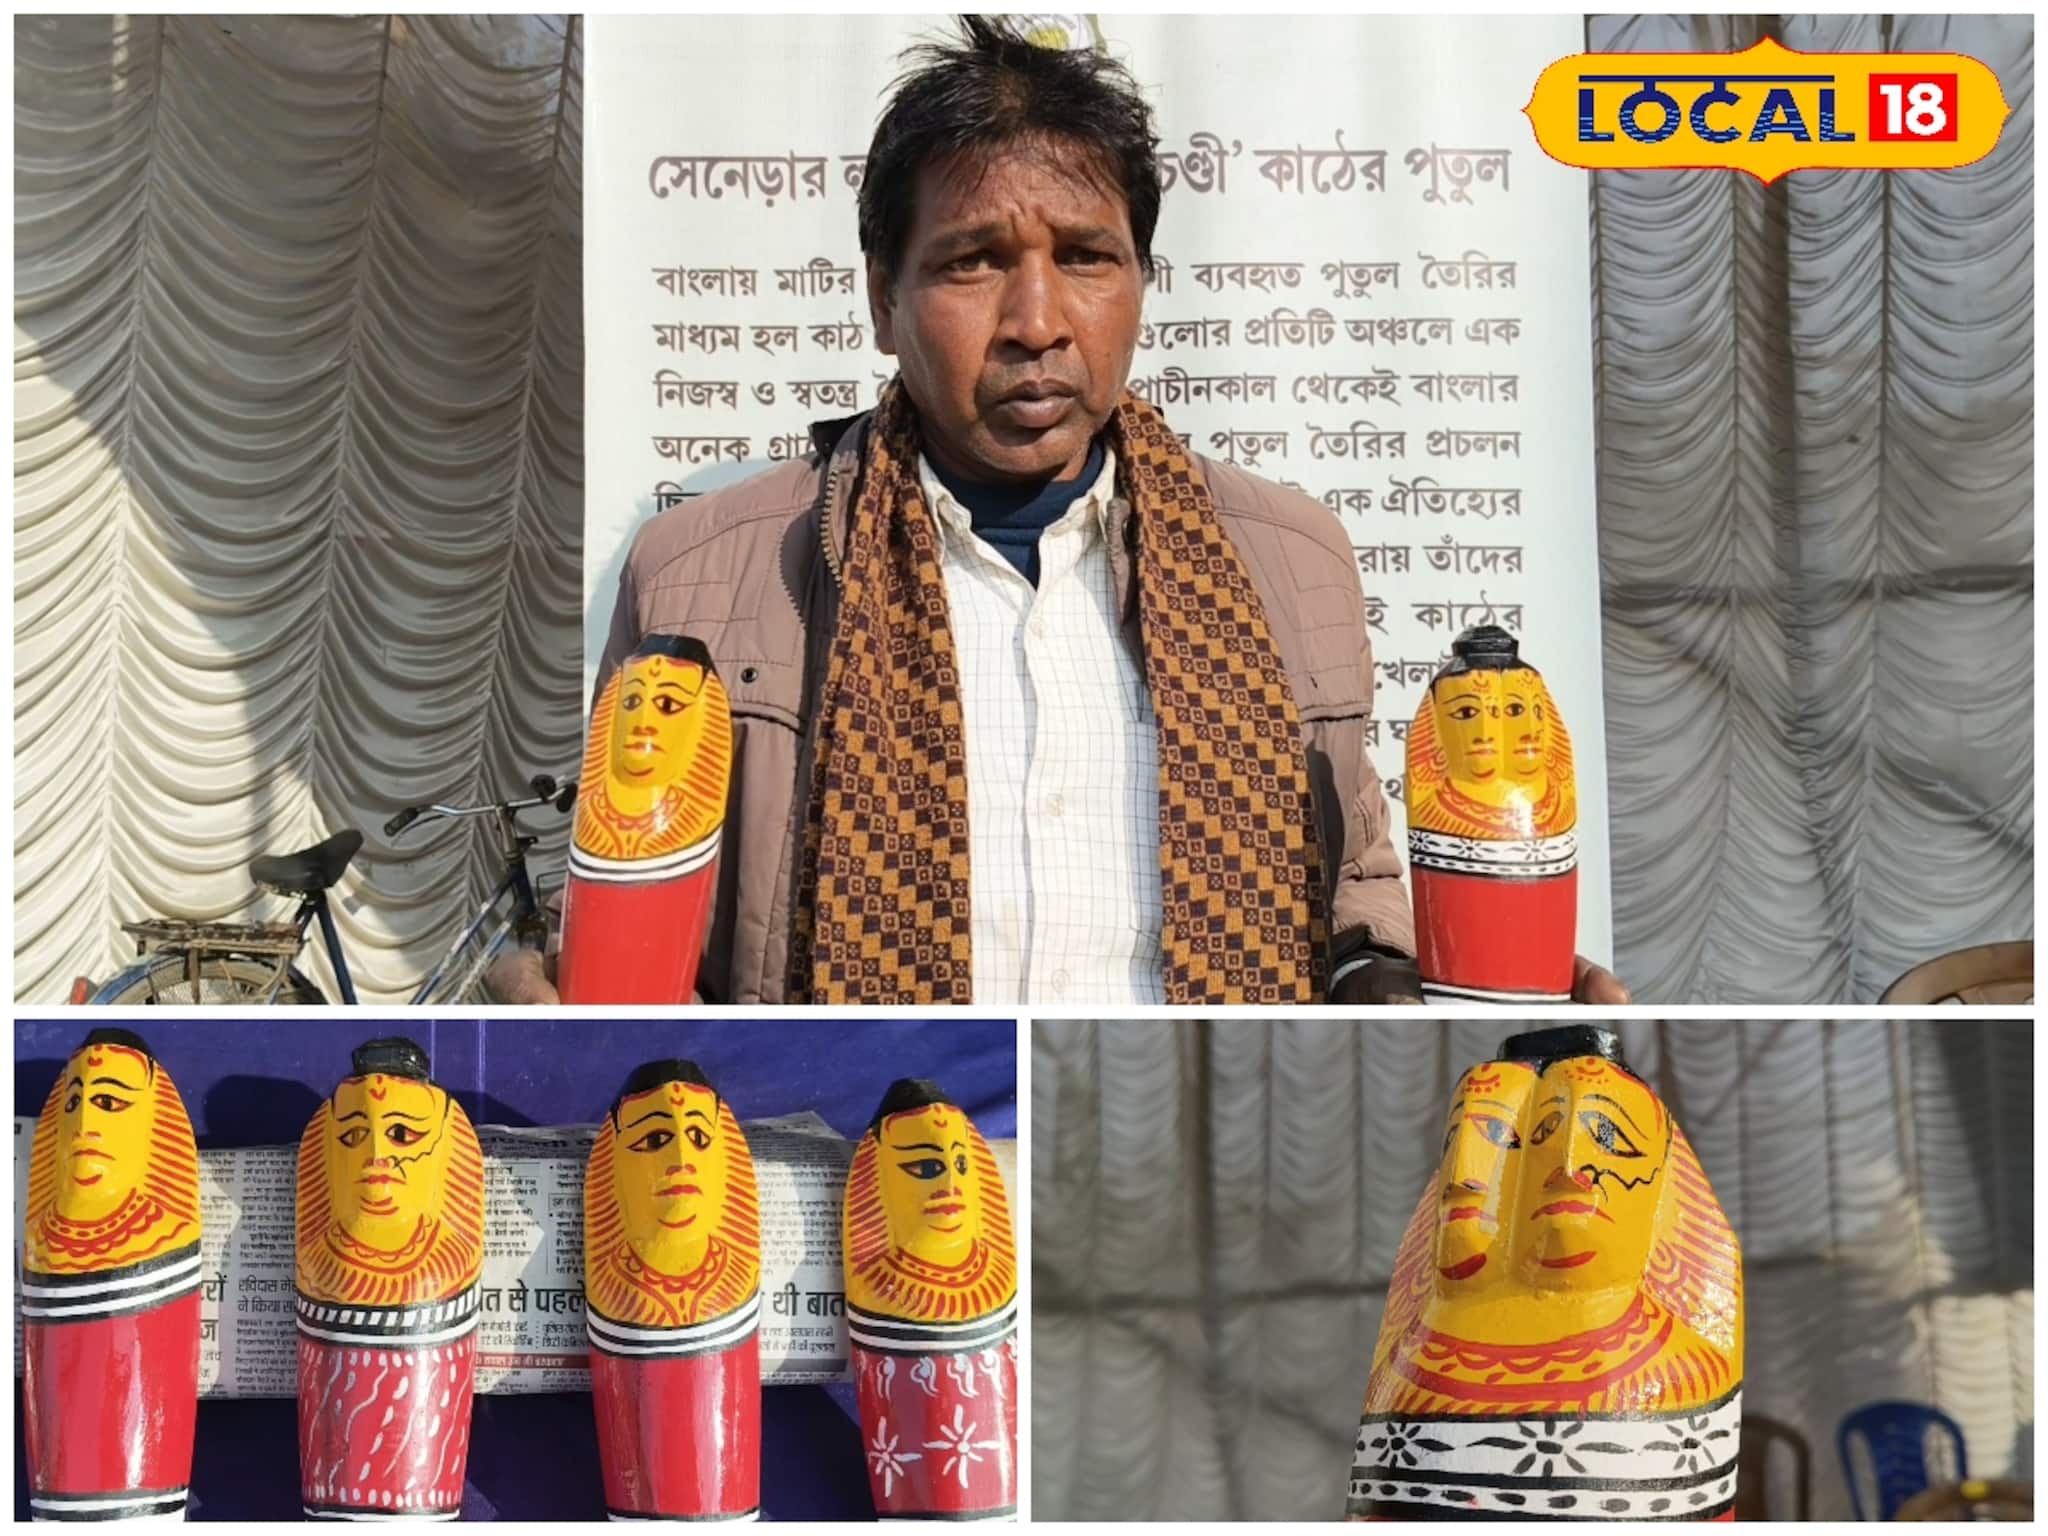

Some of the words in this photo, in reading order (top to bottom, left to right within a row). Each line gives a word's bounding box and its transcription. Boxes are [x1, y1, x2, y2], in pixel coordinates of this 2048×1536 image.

[648, 150, 828, 207] সেনেড়ার
[1253, 129, 1388, 194] কাঠের
[1404, 142, 1512, 205] পুতুল
[651, 265, 758, 297] বাংলায়
[774, 257, 856, 297] মাটির
[1190, 261, 1305, 294] ব্যবহৃত
[1320, 261, 1400, 299] পুতুল
[1417, 250, 1517, 290] তৈরির
[652, 321, 741, 353] মাধ্যম
[751, 323, 798, 356] হল
[807, 309, 865, 352] কাঠ
[1244, 307, 1336, 348] প্রতিটি
[1345, 317, 1455, 346] অঞ্চলে
[1465, 316, 1521, 345] এক
[652, 369, 738, 409] নিজস্ব
[750, 380, 776, 406] ও
[787, 379, 861, 409] স্বতন্ত্র
[1292, 366, 1401, 405] থেকেই
[1410, 372, 1520, 403] বাংলার
[651, 435, 751, 464] অনেক
[1209, 427, 1288, 466] পুতুল
[1306, 420, 1406, 460] তৈরির
[1426, 427, 1521, 461] প্রচলন
[1380, 474, 1522, 520] ঐতিহ্যের
[1422, 533, 1524, 575] তাঁদের
[1411, 590, 1524, 632] কাঠের
[508, 1278, 529, 1312] से
